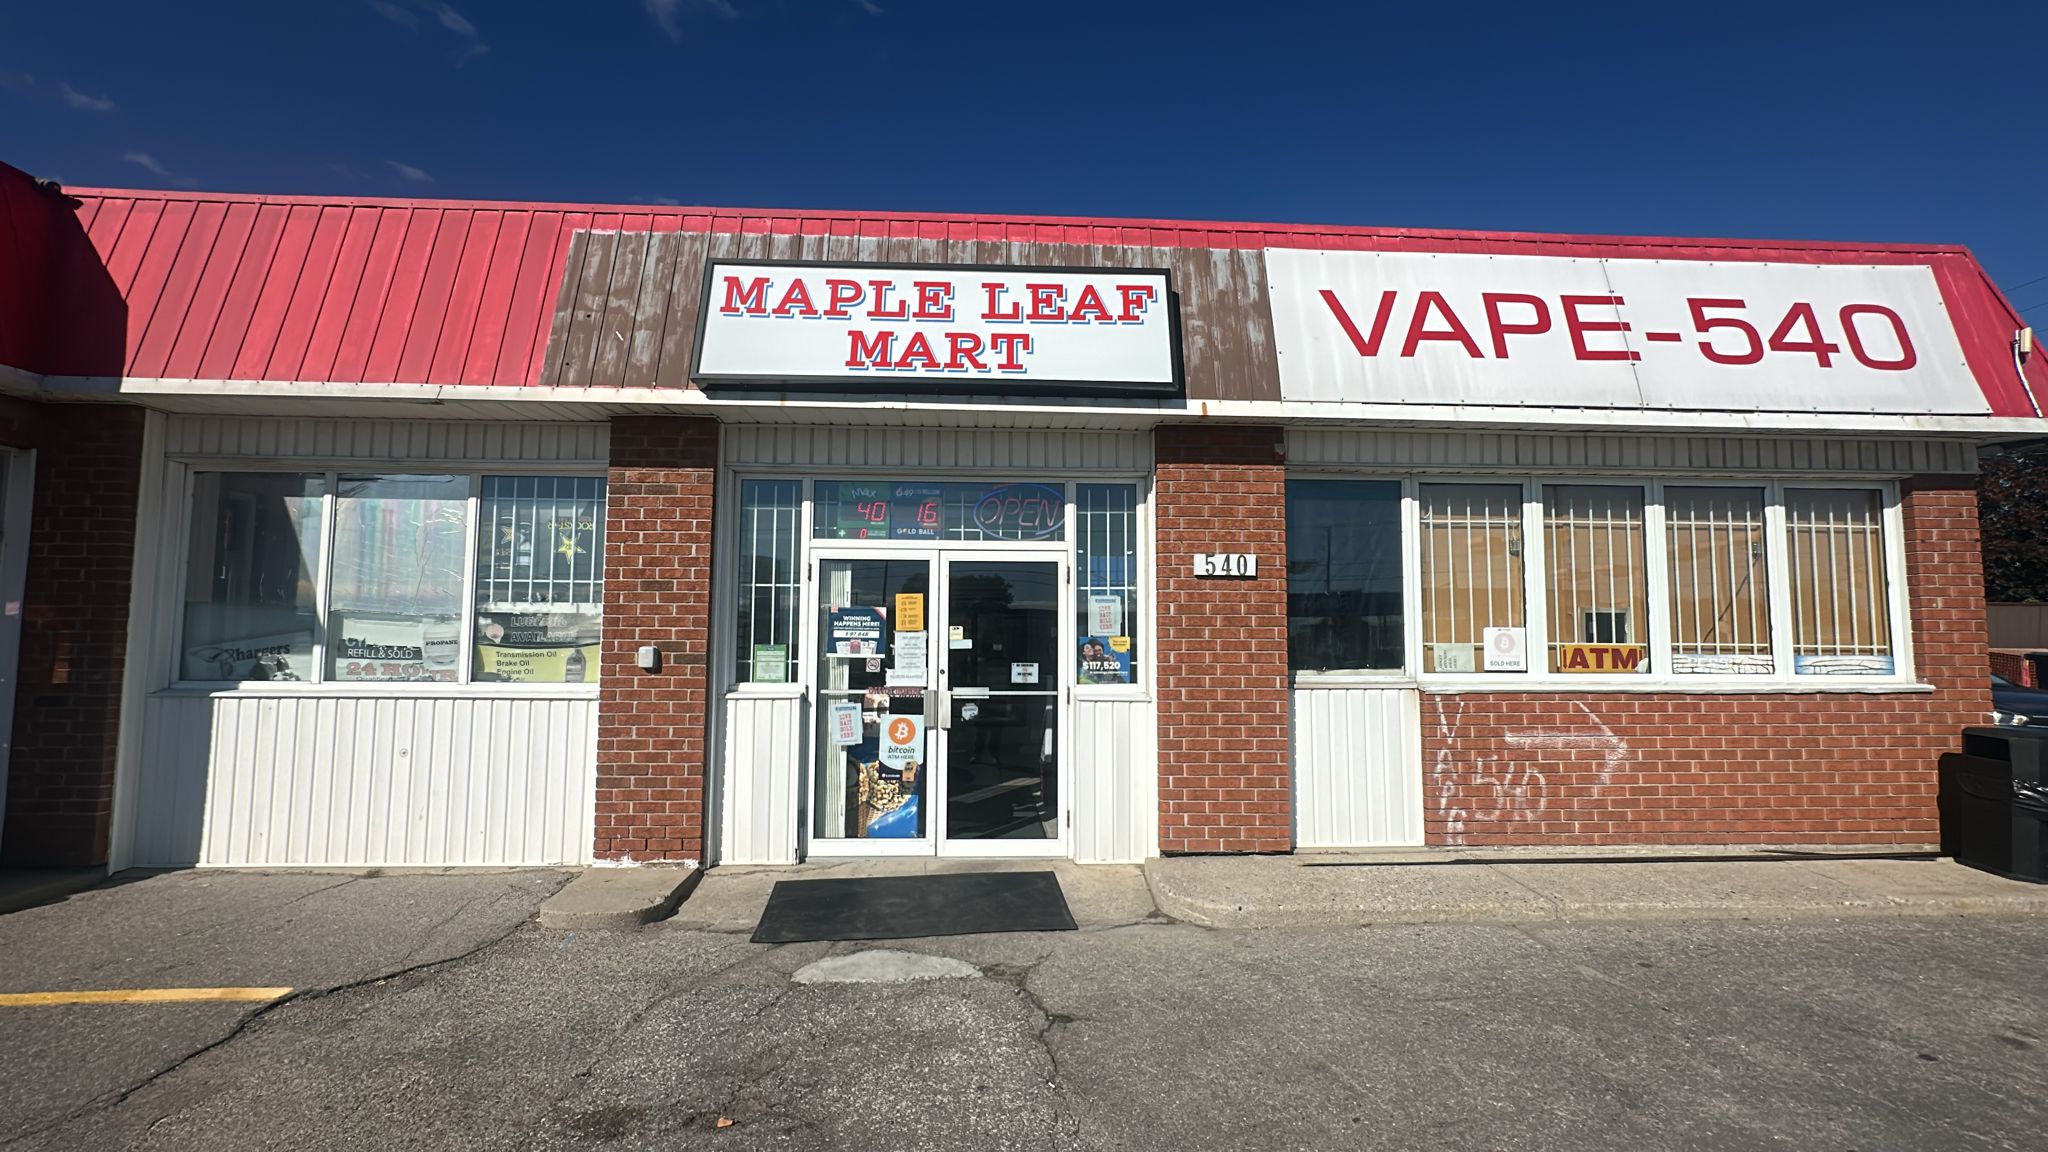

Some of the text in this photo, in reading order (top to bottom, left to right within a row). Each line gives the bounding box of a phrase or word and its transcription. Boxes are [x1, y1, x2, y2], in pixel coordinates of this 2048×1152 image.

[720, 275, 1158, 325] MAPLE LEAF
[1318, 289, 1918, 371] VAPE-540
[844, 329, 1035, 373] MART
[857, 501, 886, 522] 40
[917, 502, 937, 522] 16
[980, 497, 1060, 527] OPEN
[1205, 553, 1248, 575] 540
[347, 648, 376, 658] REFILL
[388, 649, 414, 659] SOLD
[1567, 647, 1639, 669] ATM
[346, 661, 377, 676] 24
[1082, 661, 1121, 671] $117,520
[887, 745, 915, 754] bitcoin
